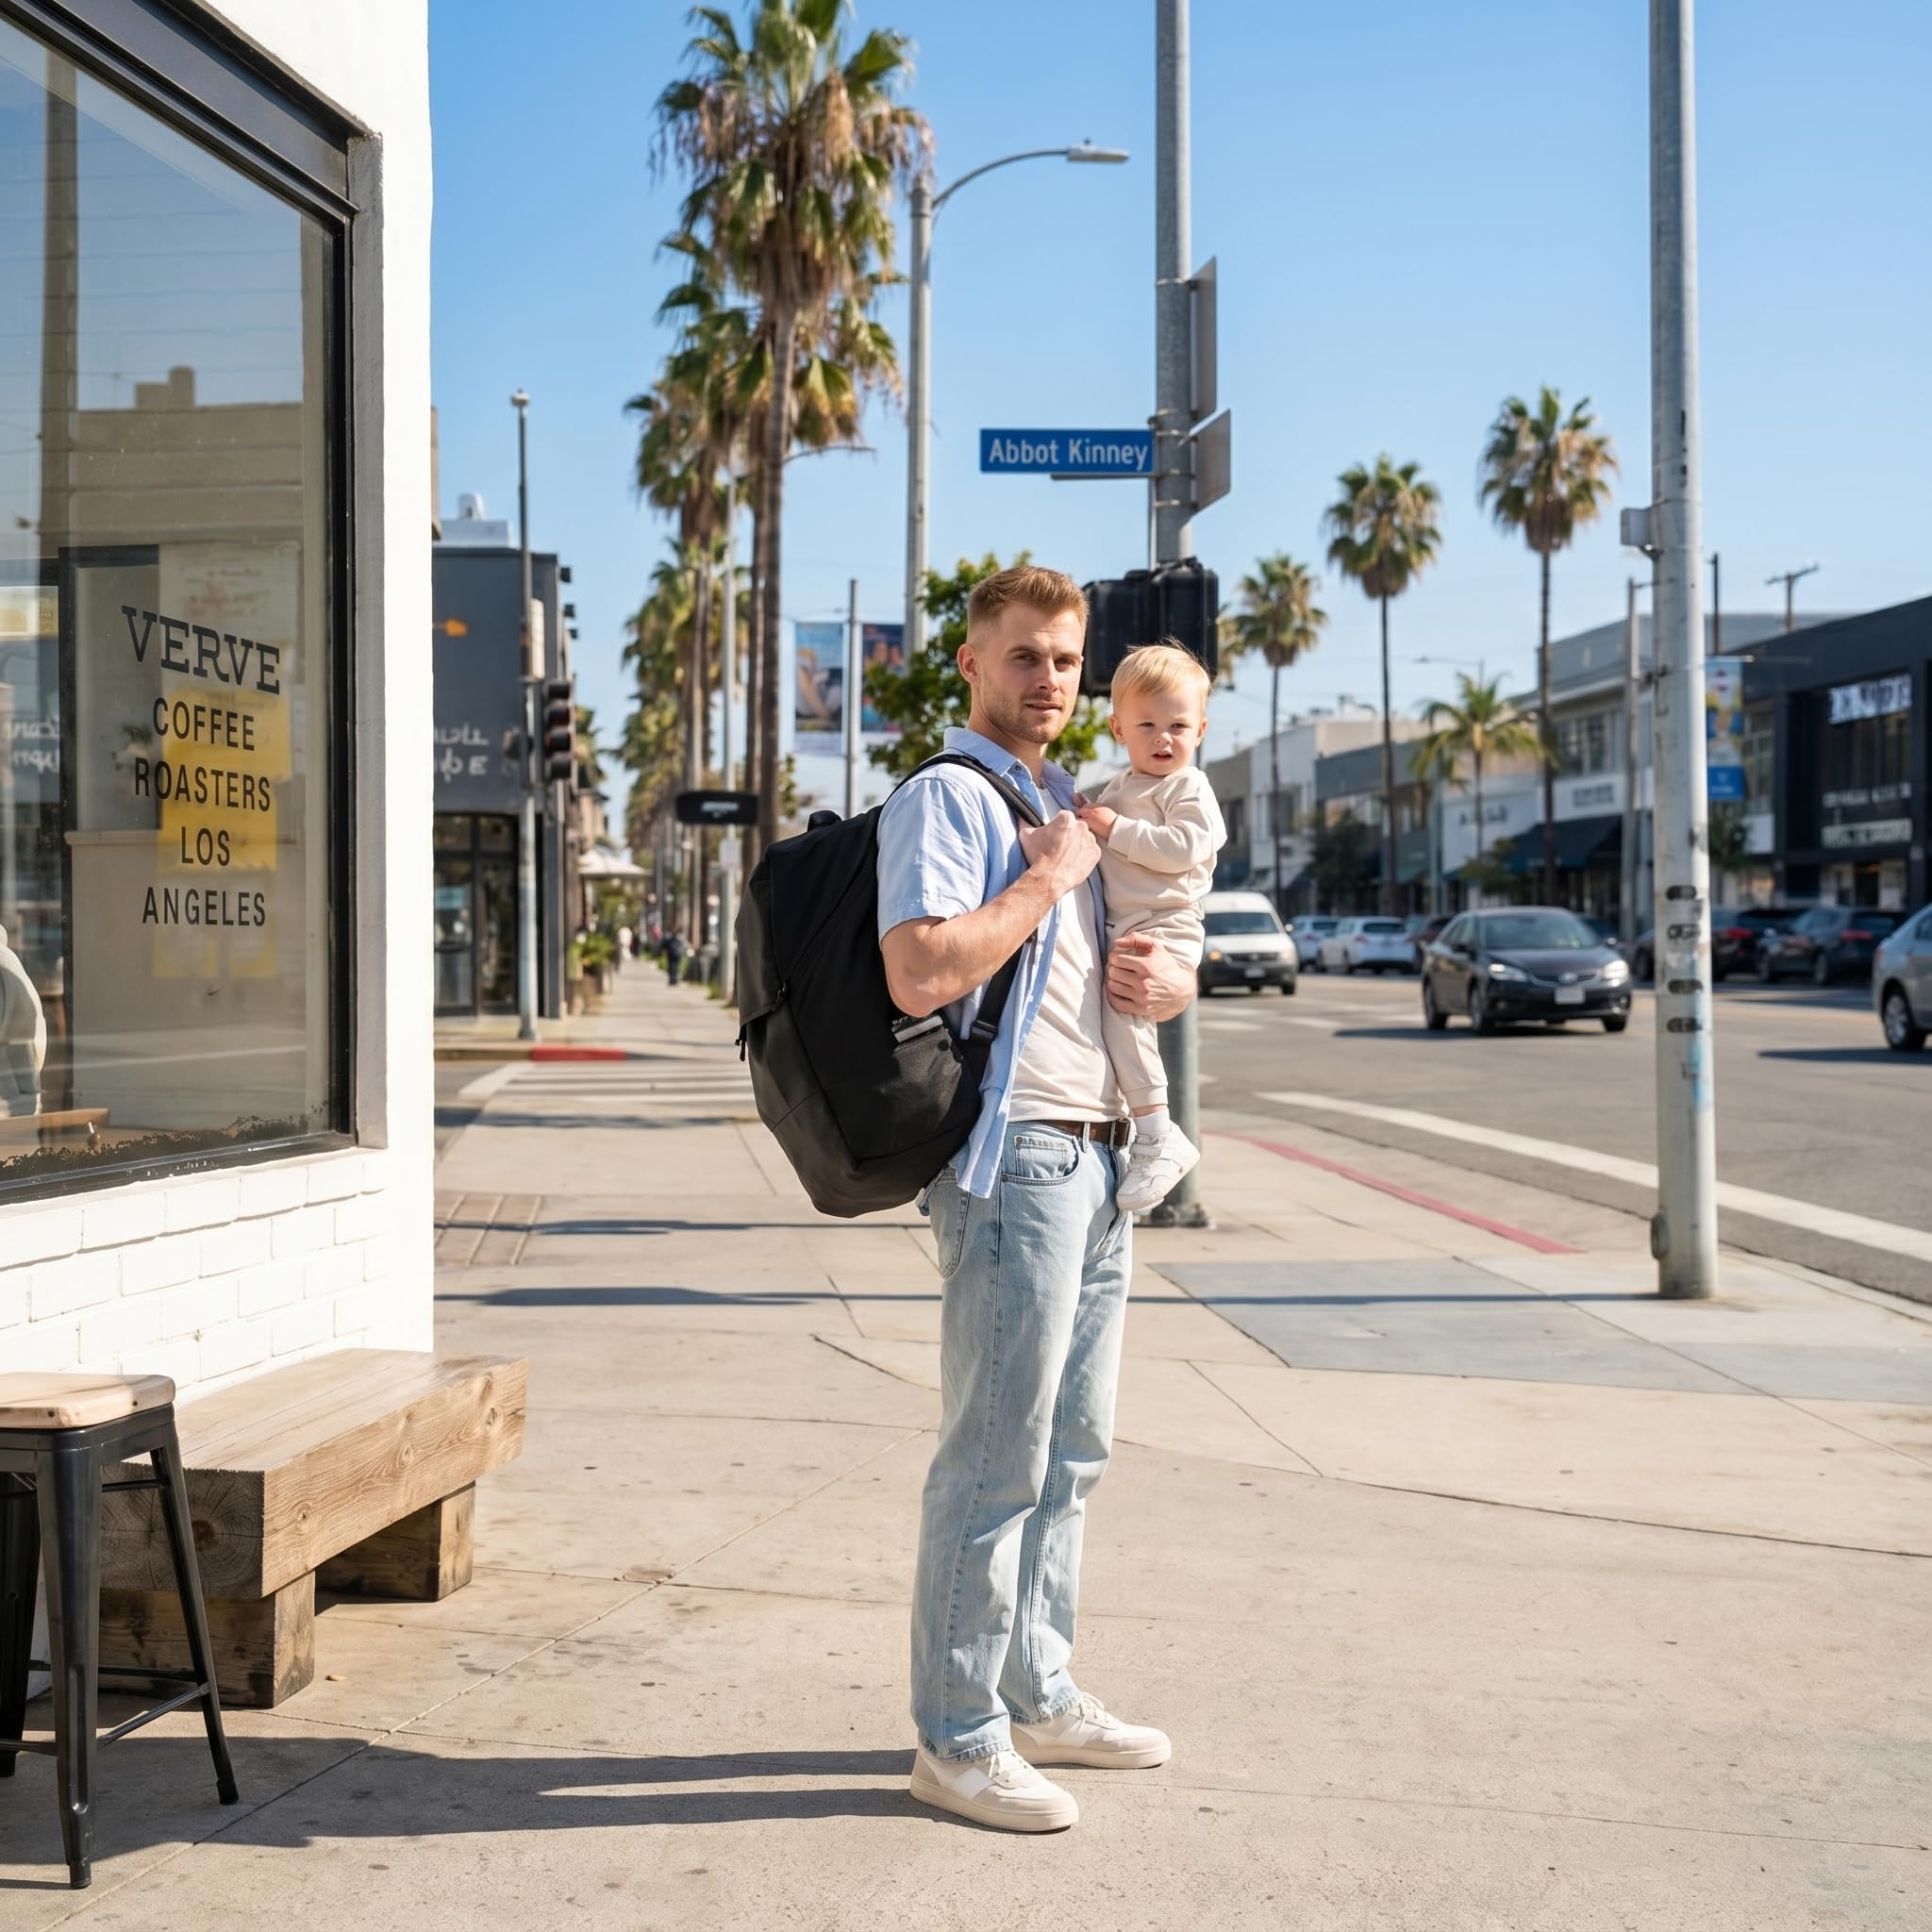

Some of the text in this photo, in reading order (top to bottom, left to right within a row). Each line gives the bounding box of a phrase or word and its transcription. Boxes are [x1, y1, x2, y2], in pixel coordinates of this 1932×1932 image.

[989, 438, 1148, 470] Abbot Kinney
[121, 605, 281, 695] VERVE
[152, 697, 256, 751] COFFEE
[135, 756, 272, 812] ROASTERS
[180, 825, 231, 867] LOS
[142, 886, 266, 927] ANGELES
